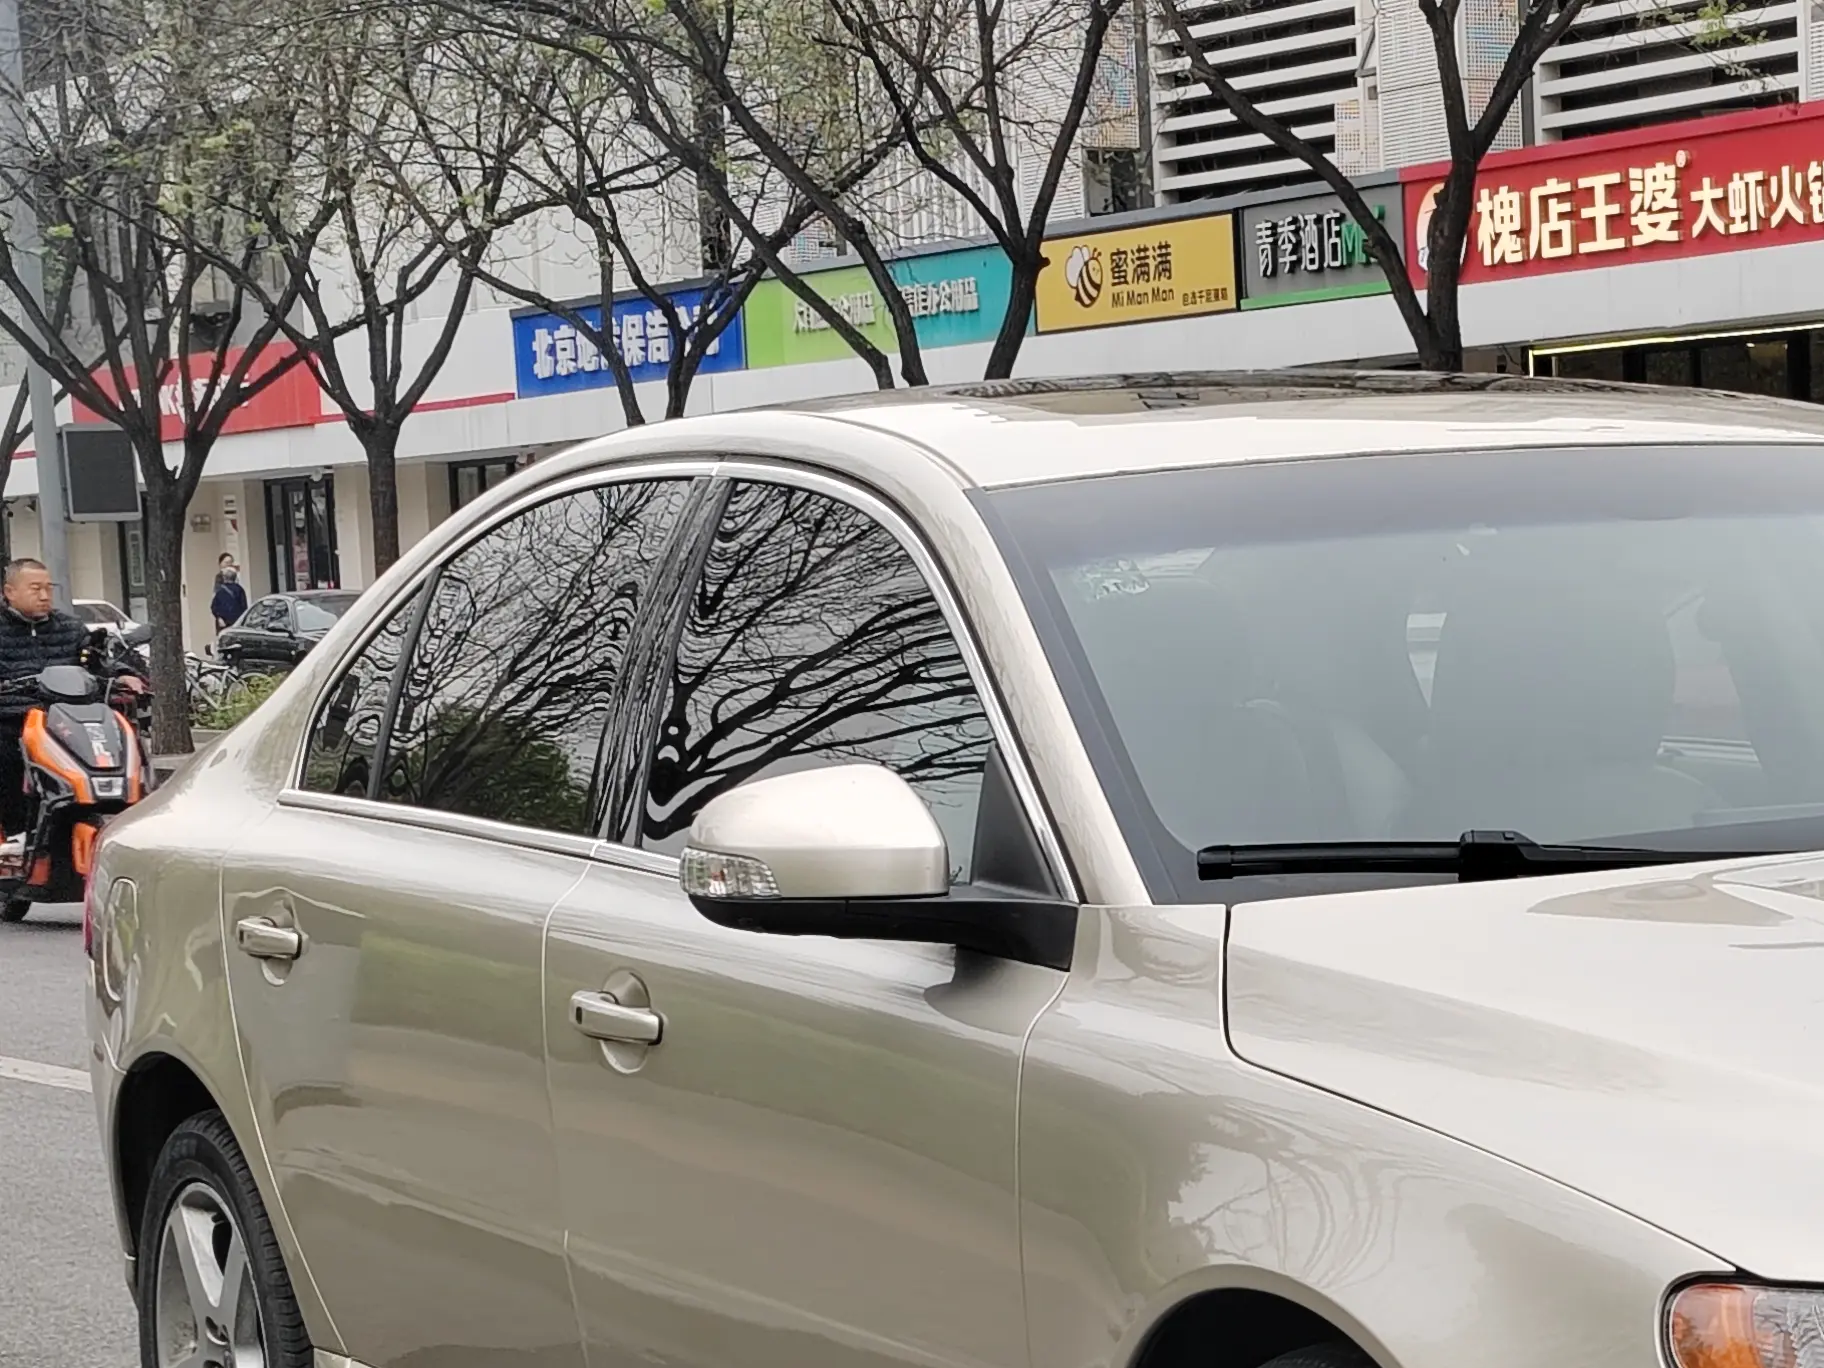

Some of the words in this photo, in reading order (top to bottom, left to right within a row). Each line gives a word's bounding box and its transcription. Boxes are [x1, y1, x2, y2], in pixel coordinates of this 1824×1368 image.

[1477, 160, 1682, 267] 槐店王婆
[1110, 240, 1172, 287] 蜜满满
[1111, 291, 1125, 308] Mi
[1126, 289, 1149, 307] Man
[1151, 286, 1175, 304] Man
